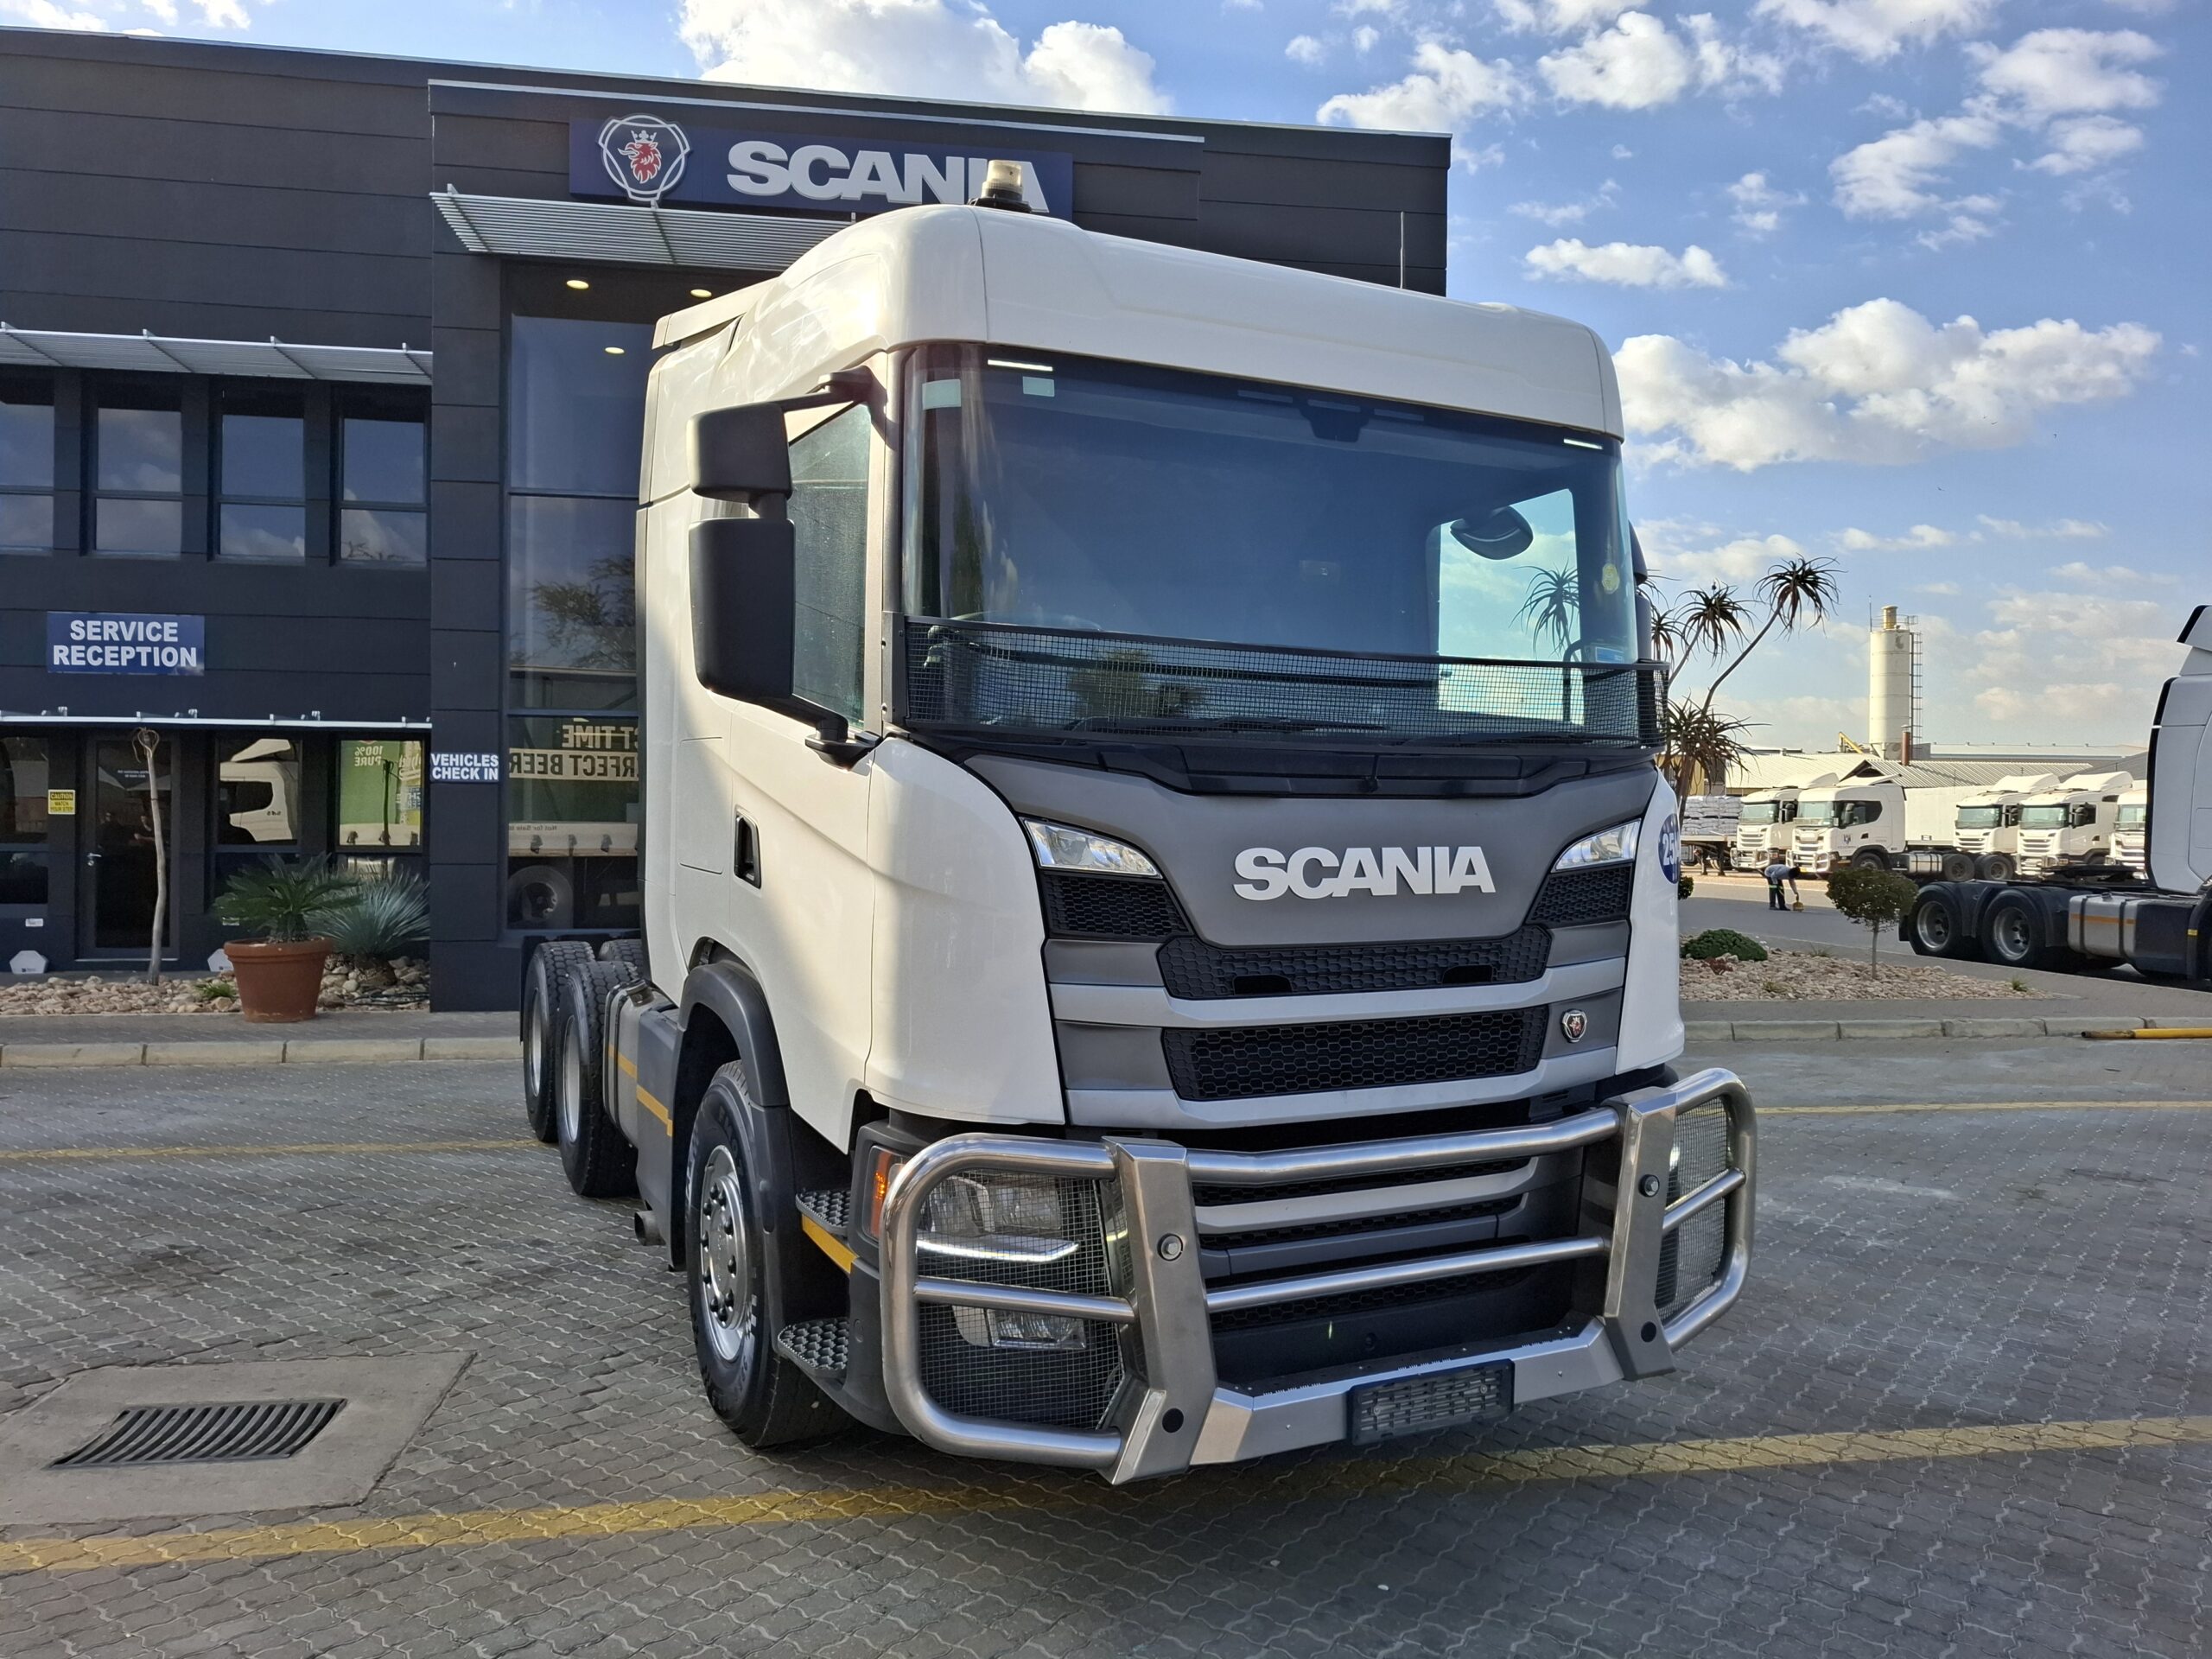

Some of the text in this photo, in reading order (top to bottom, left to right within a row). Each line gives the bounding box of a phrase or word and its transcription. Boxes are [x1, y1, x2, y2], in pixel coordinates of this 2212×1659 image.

[70, 620, 178, 642] SERVICE
[54, 645, 197, 667] RECEPTION
[431, 753, 499, 767] VEHICLES
[432, 766, 499, 780] CHECK IN
[1233, 846, 1497, 901] SCANIA
